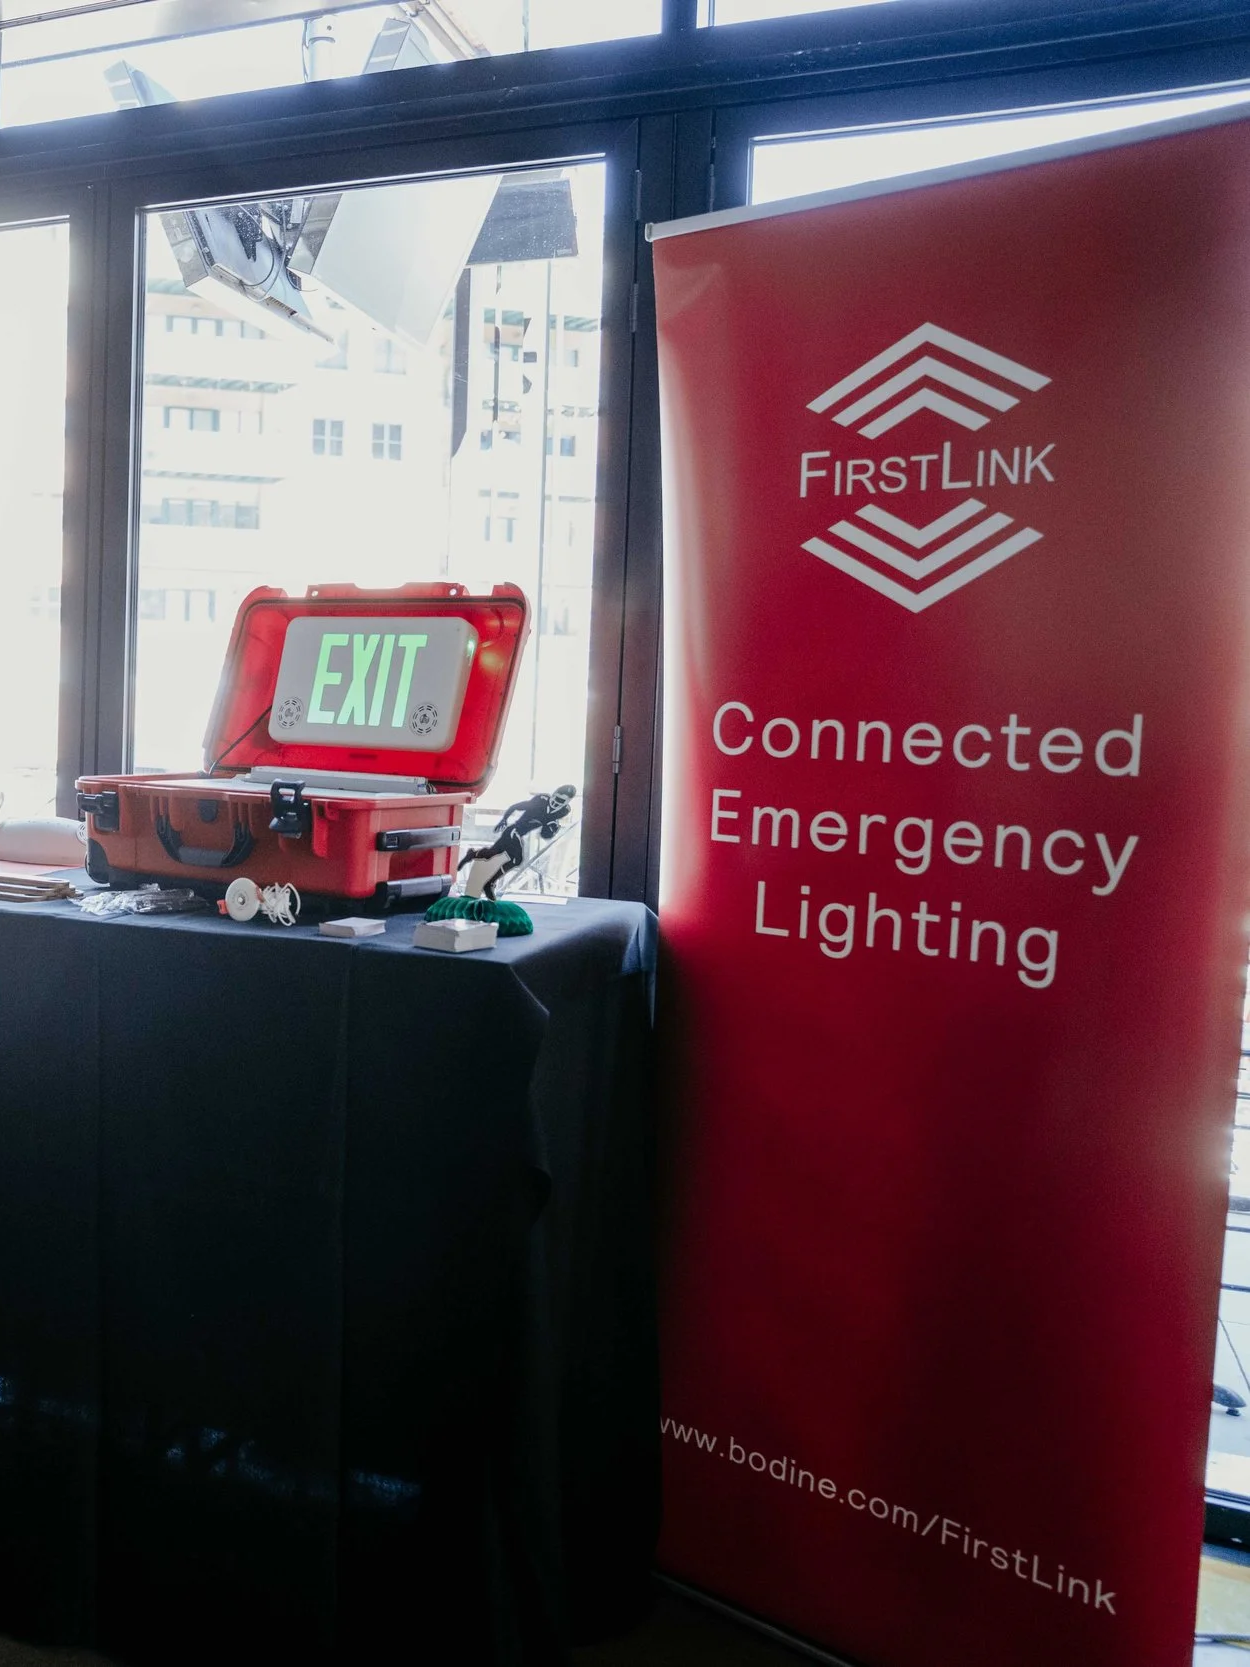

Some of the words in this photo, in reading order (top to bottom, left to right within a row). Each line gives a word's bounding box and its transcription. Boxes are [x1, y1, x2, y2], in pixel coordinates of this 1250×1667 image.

[307, 633, 428, 728] EXIT
[712, 701, 1144, 777] Connected
[710, 788, 1139, 897] Emergency
[754, 880, 1059, 989] Lighting
